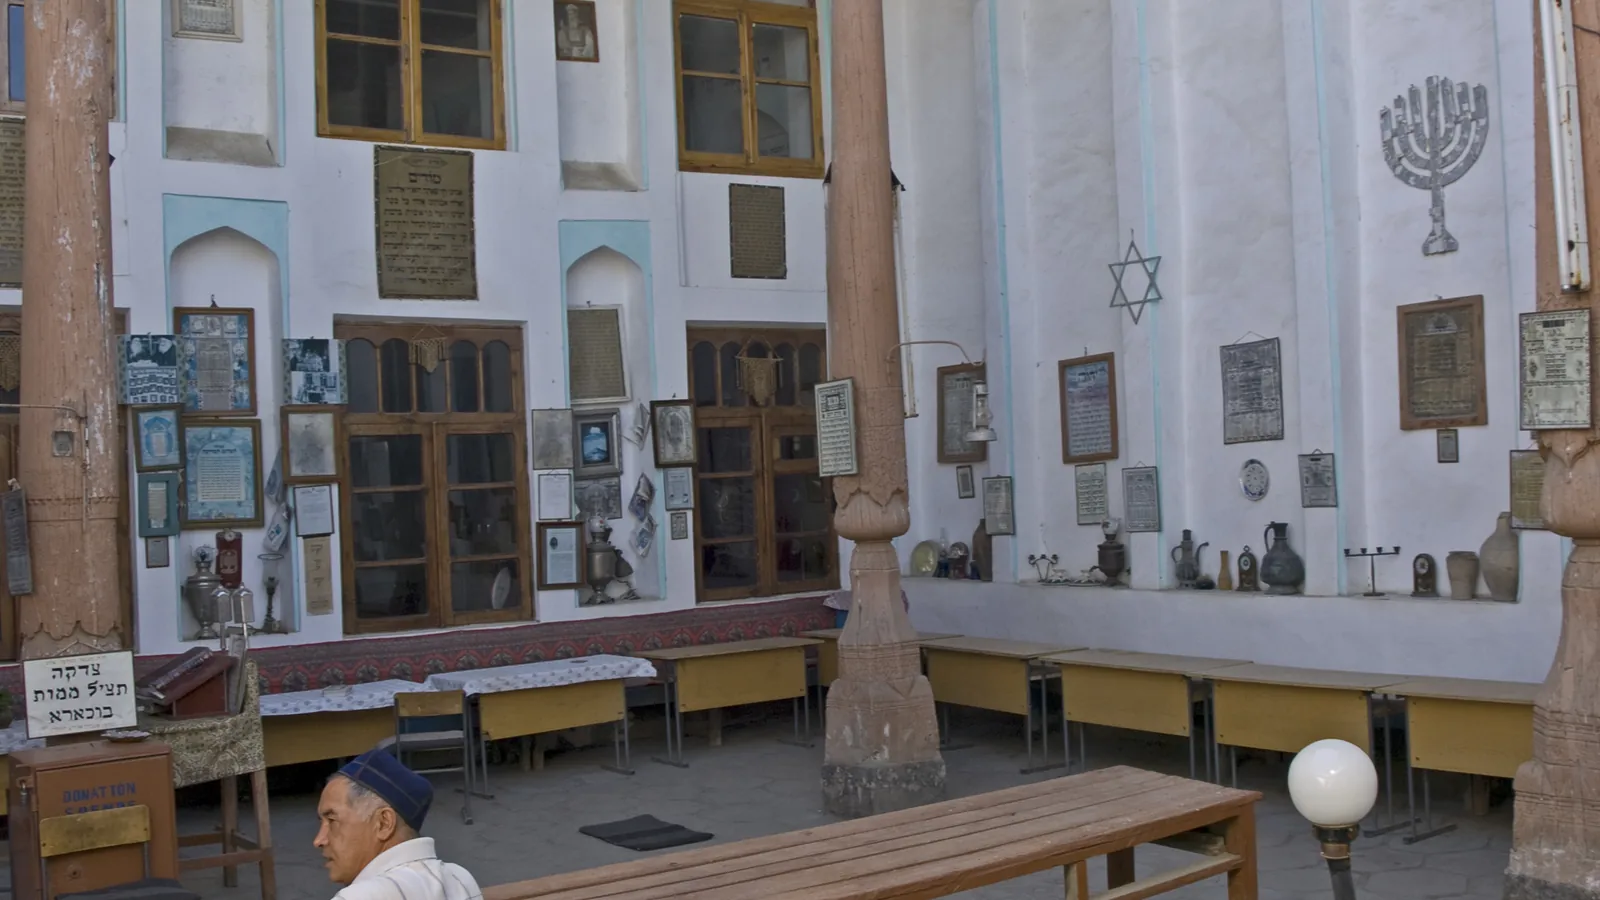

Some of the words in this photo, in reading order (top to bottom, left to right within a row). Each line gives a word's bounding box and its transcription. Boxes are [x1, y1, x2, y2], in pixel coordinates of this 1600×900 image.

[51, 663, 101, 683] צדקה
[33, 686, 80, 702] ממות
[87, 680, 128, 697] תציל
[49, 706, 114, 724] בוכארא
[63, 782, 136, 802] DONATION
